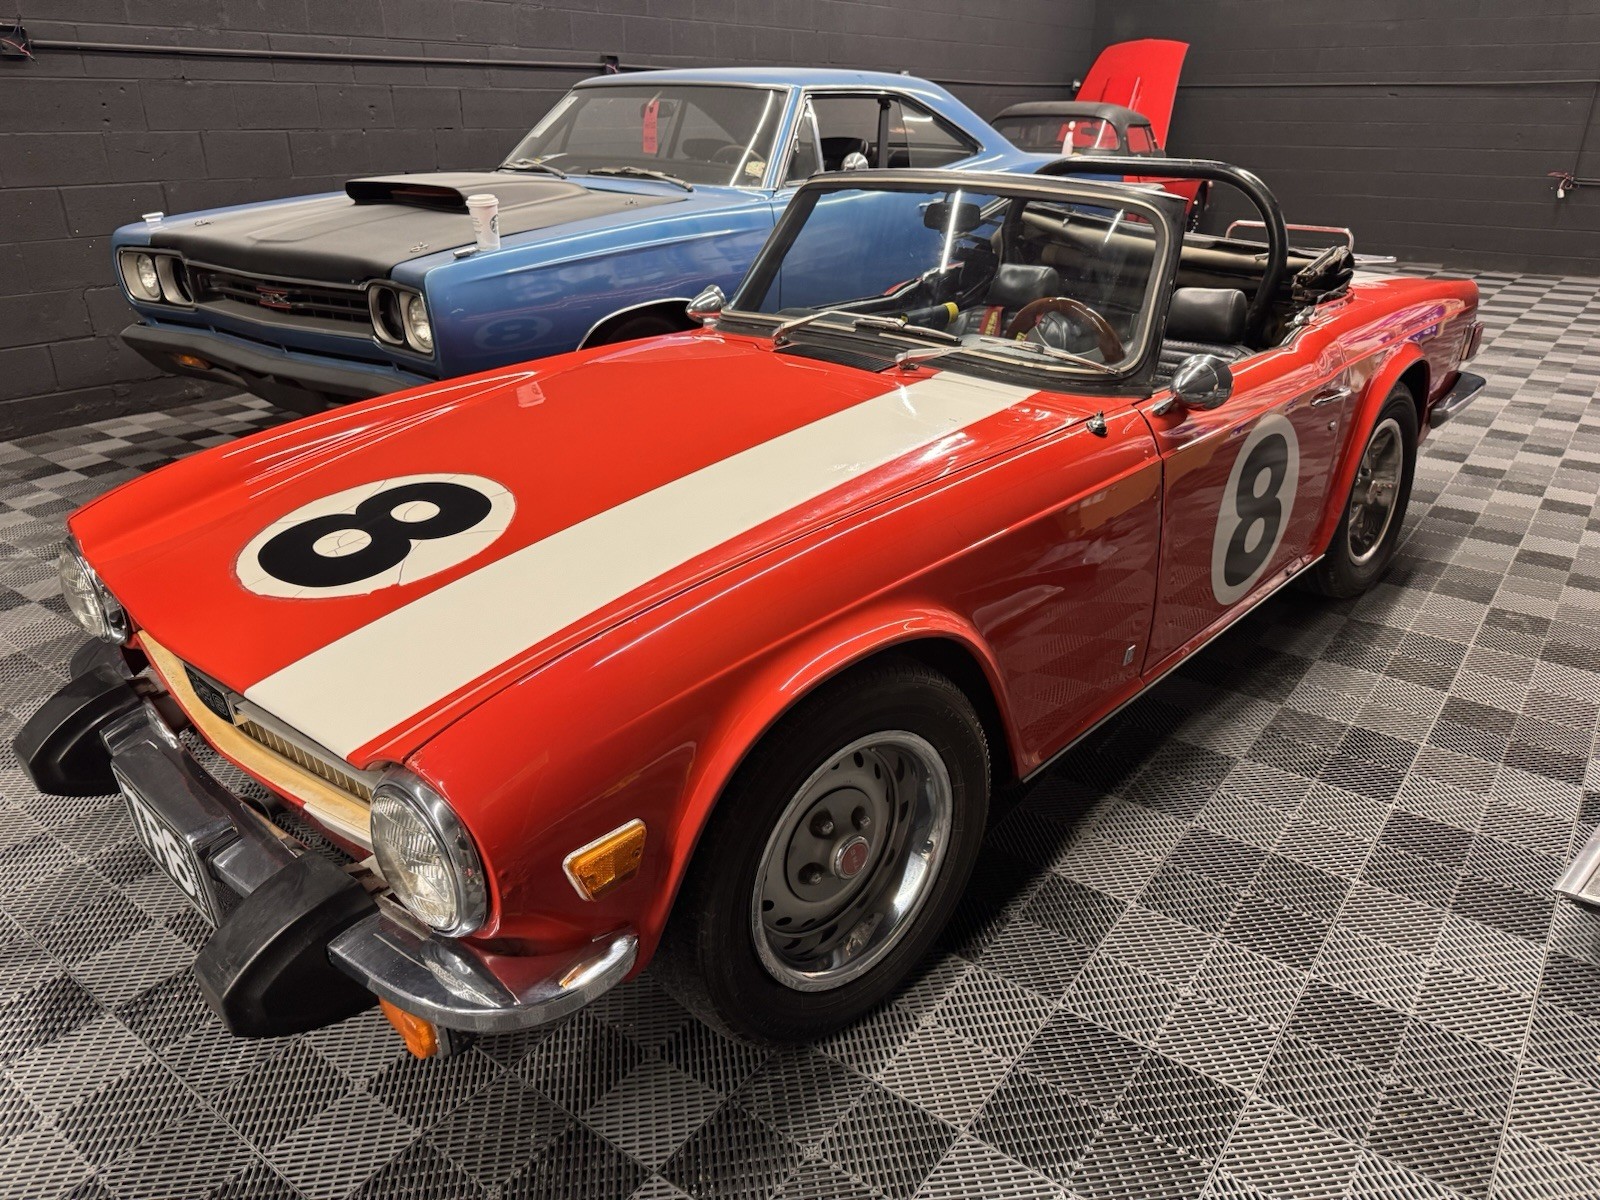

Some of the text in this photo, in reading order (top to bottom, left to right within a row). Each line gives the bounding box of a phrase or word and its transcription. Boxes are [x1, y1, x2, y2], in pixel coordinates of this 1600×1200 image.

[257, 482, 492, 588] 8
[1224, 433, 1288, 587] 8
[120, 780, 196, 896] TR6
